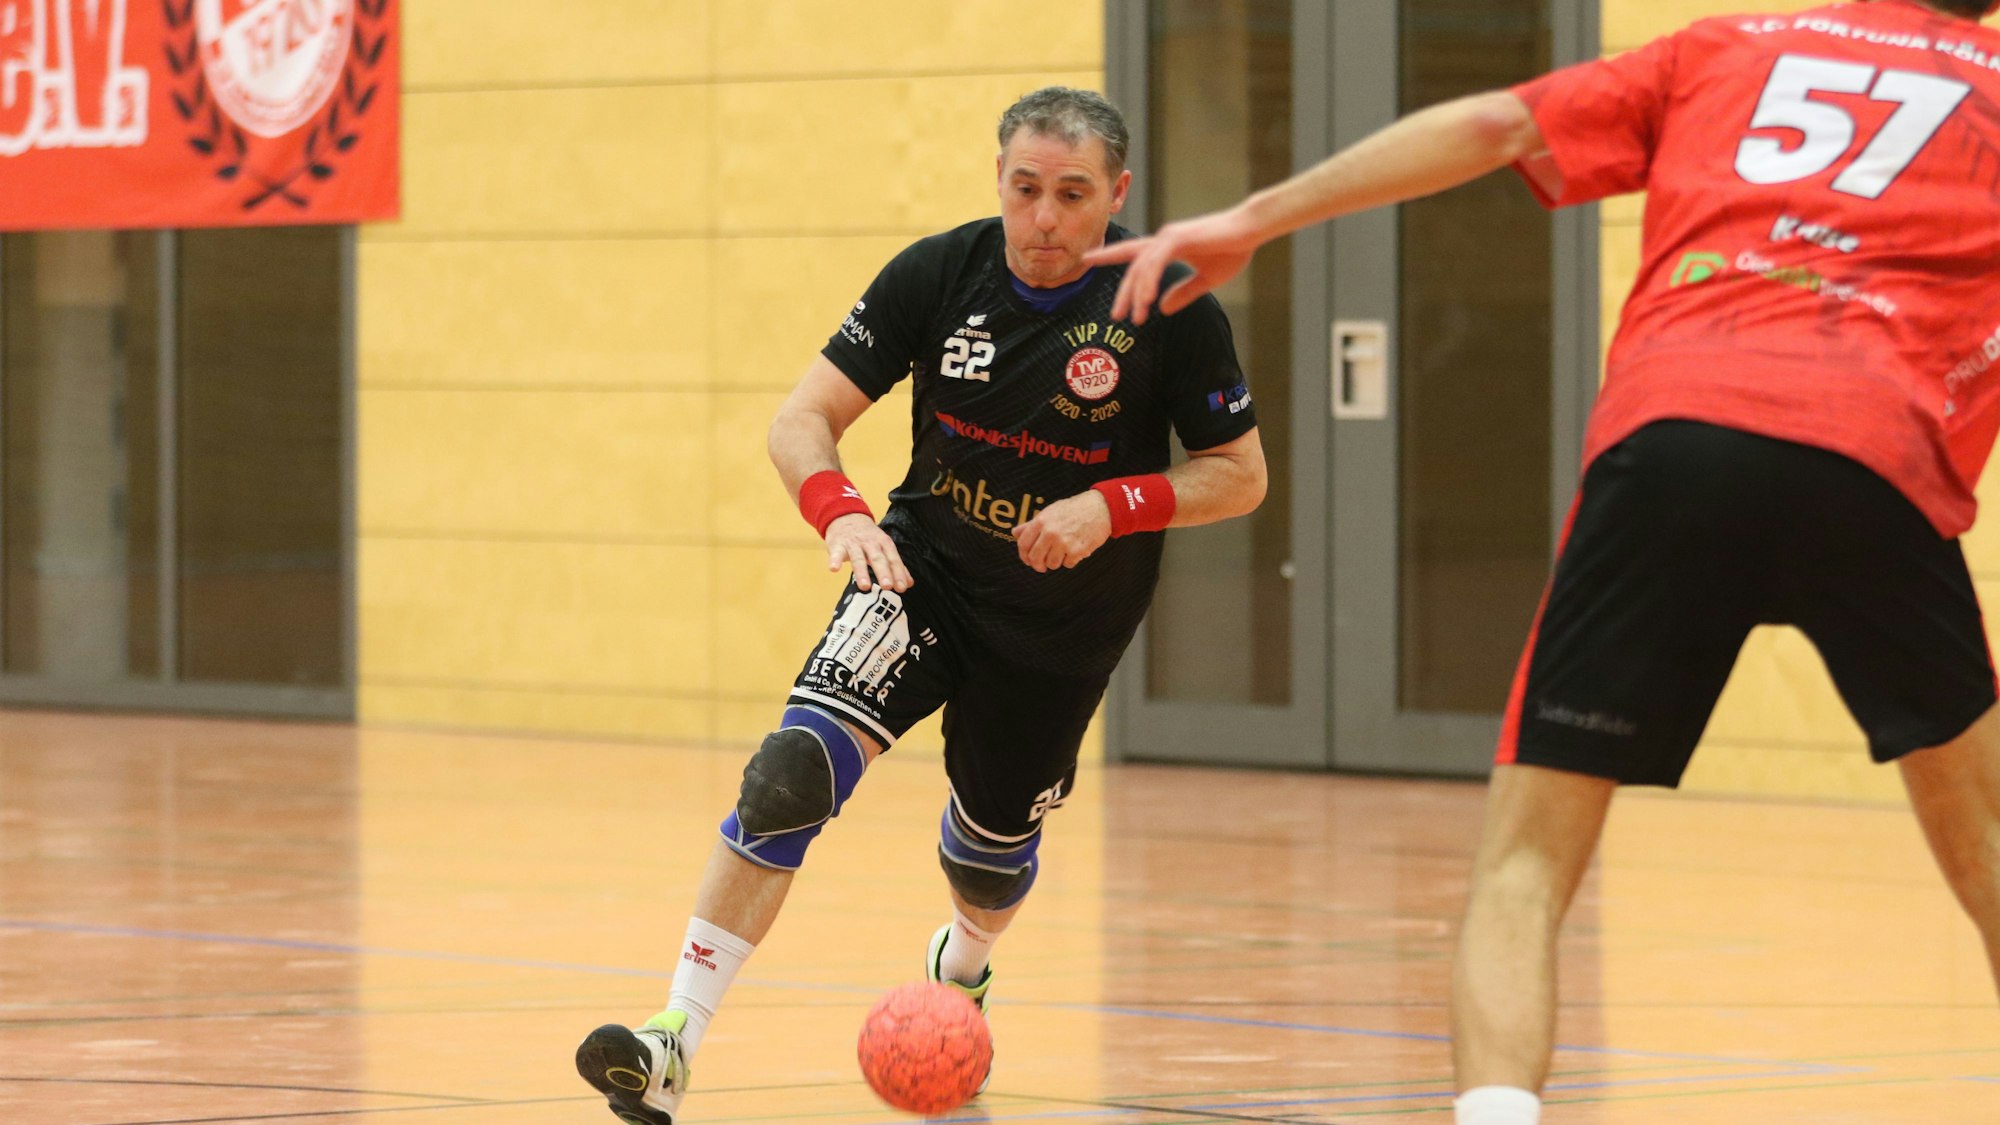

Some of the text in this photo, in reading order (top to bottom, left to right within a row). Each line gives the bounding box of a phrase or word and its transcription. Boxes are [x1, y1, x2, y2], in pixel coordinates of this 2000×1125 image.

[1792, 17, 1929, 50] FORTUNA
[1734, 52, 1973, 200] 57
[1063, 322, 1134, 353] TVP 100
[940, 336, 996, 382] 22
[1076, 357, 1106, 376] TVP
[1079, 373, 1108, 389] 1920
[1050, 394, 1080, 419] 1920
[1090, 400, 1121, 422] 2020
[955, 418, 1089, 465] KÖNIGSHOVEN
[808, 658, 888, 707] BECKER
[684, 951, 717, 971] erima
